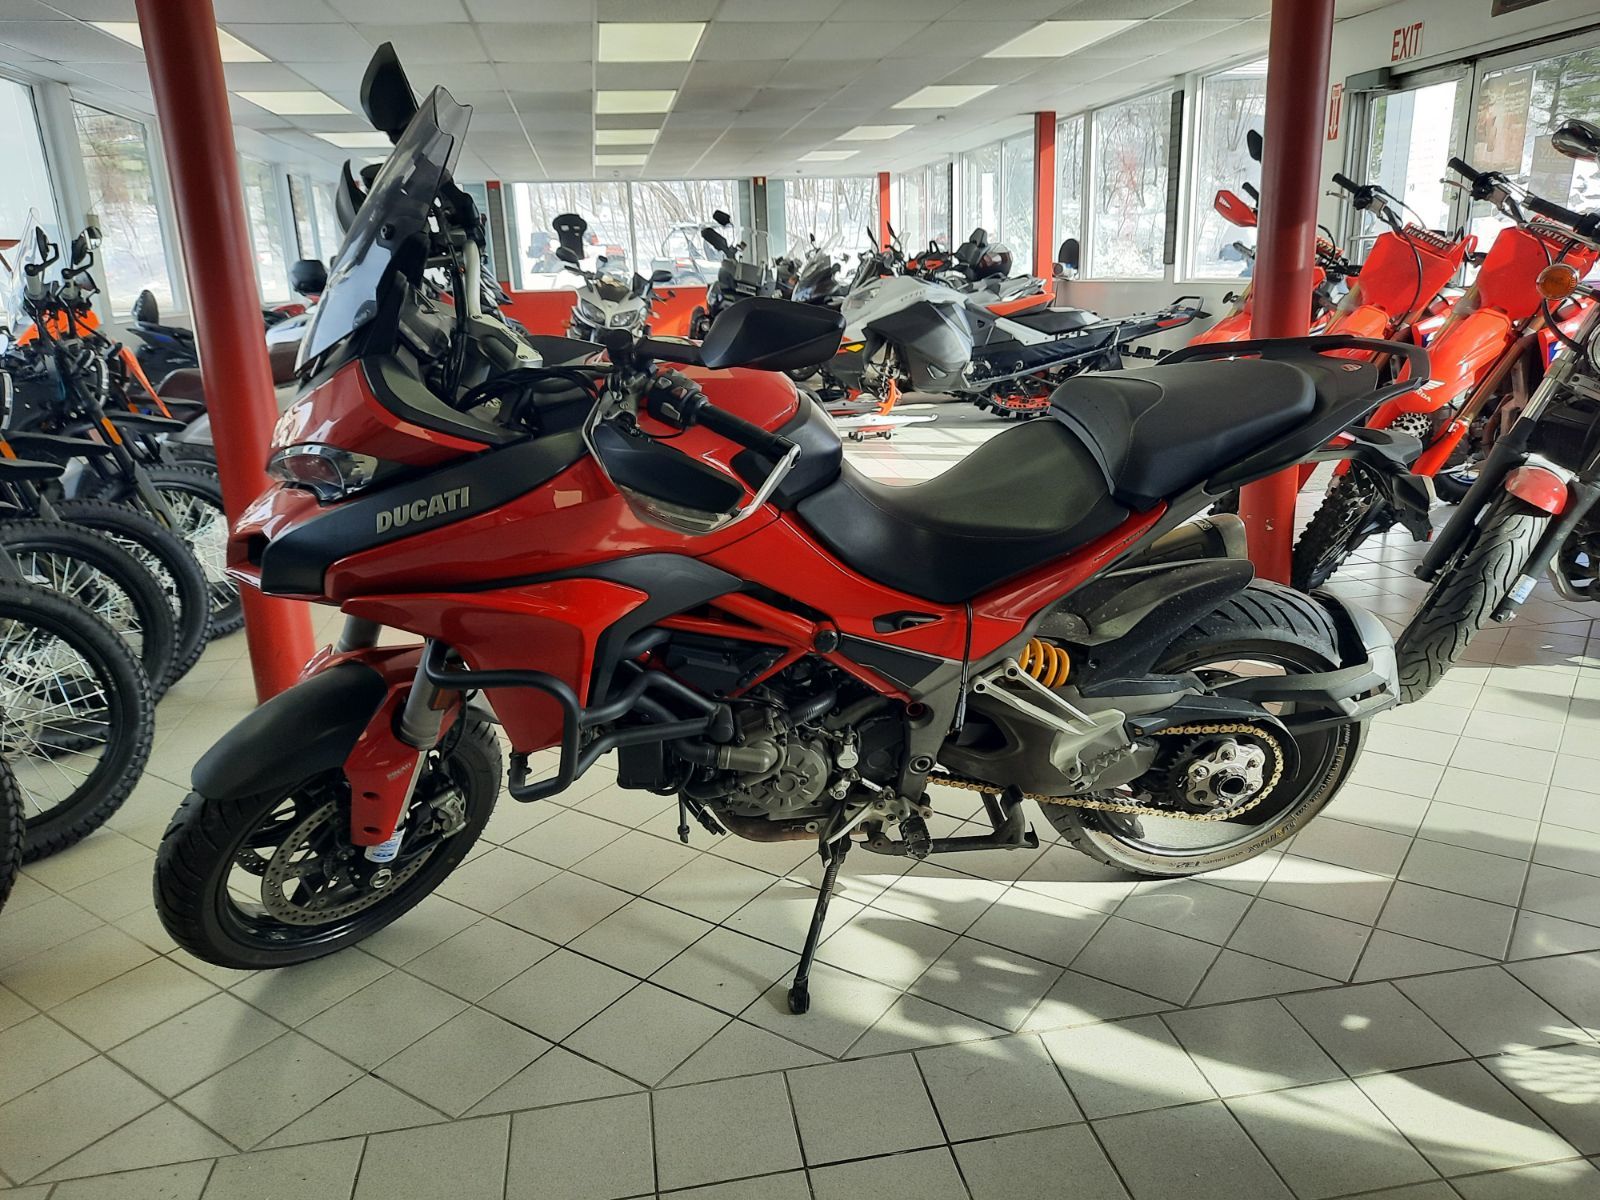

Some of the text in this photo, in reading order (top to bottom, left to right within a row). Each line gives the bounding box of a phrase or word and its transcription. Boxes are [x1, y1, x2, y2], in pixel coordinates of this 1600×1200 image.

[1391, 22, 1423, 62] EXIT
[1406, 228, 1447, 250] RENTHAL
[376, 486, 470, 534] DUCATI
